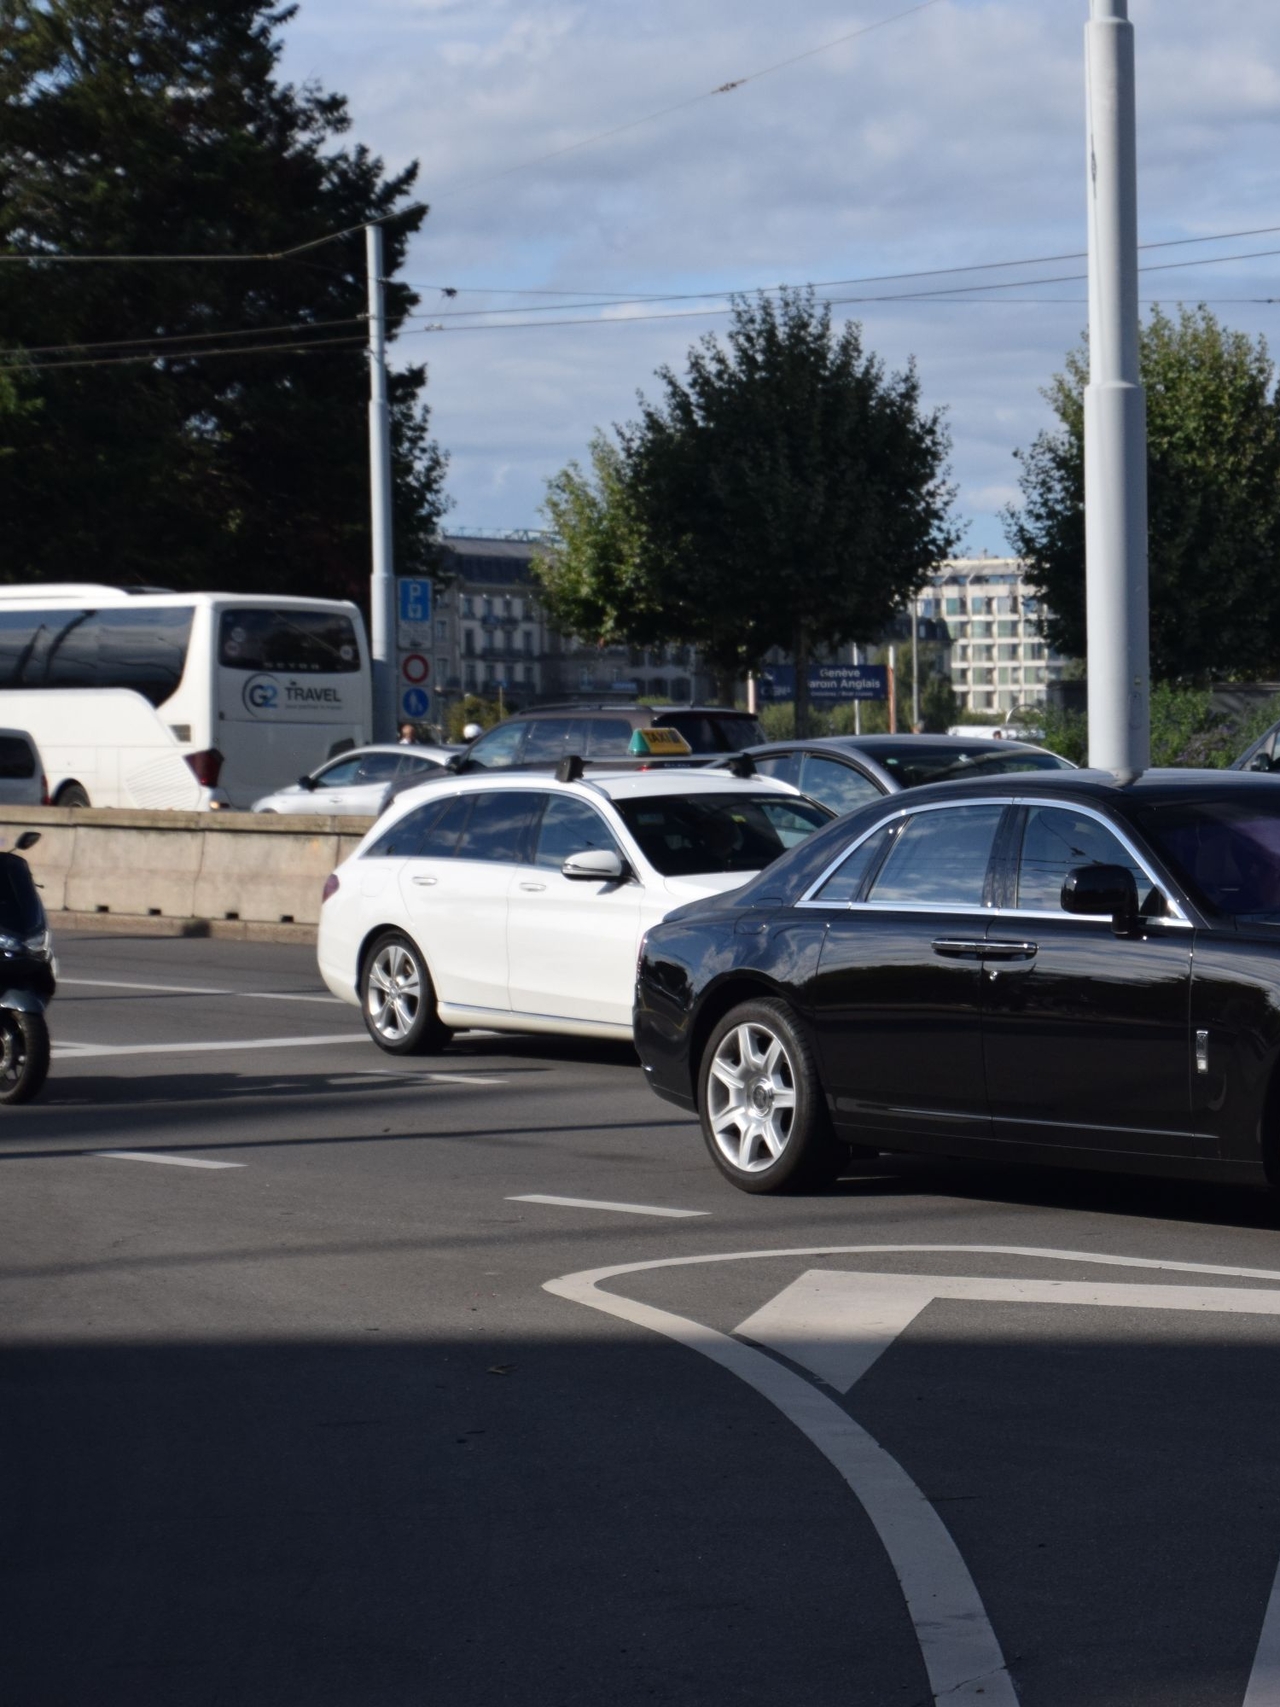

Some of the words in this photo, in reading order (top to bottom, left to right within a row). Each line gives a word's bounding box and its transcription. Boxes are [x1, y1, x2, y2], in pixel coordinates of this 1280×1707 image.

[409, 584, 421, 604] P
[819, 667, 860, 678] Genève
[840, 679, 881, 690] Anglais
[284, 686, 342, 703] TRAVEL
